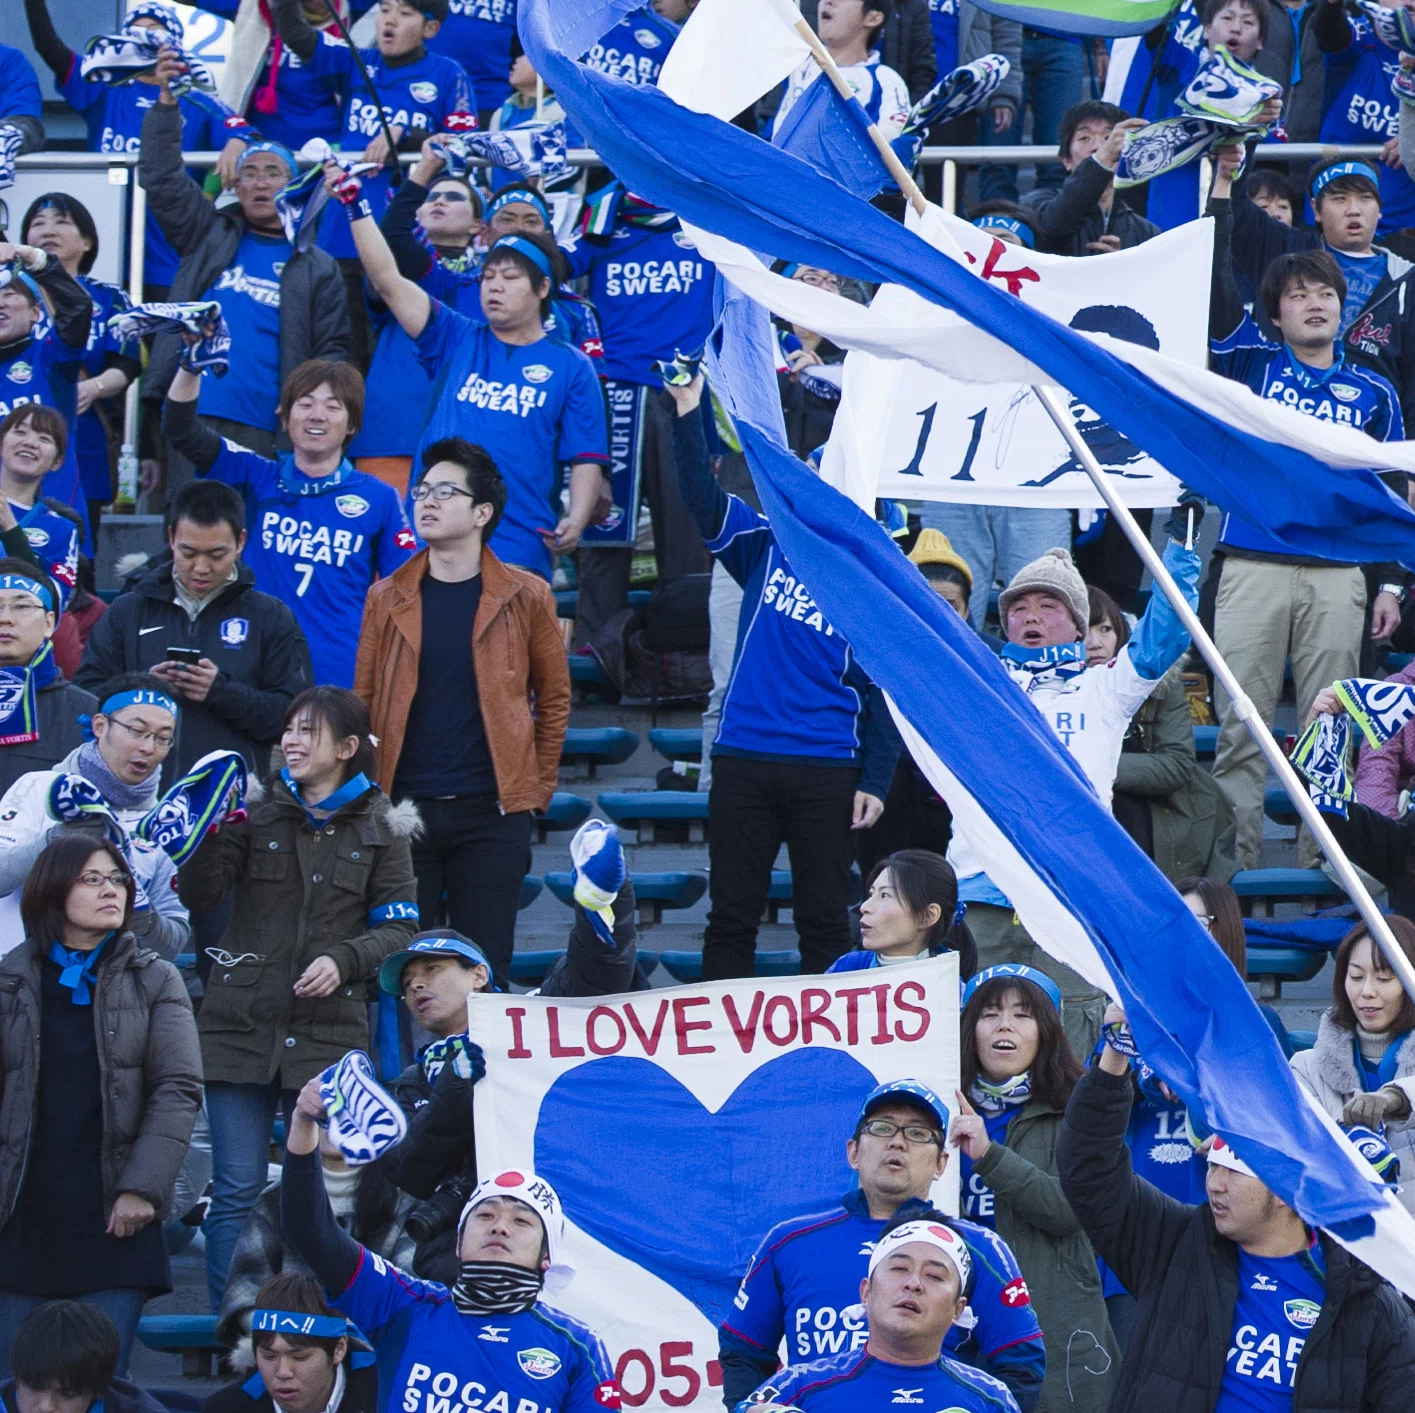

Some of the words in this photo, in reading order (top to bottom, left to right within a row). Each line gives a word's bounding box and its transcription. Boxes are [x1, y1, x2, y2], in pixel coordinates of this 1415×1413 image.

[1316, 164, 1379, 186] J1へ!!
[606, 260, 703, 286] POCARI
[606, 276, 692, 297] SWEAT
[899, 402, 988, 482] 11
[260, 531, 351, 568] SWEAT
[262, 511, 365, 555] POCARI
[296, 564, 314, 597] 7
[505, 1006, 534, 1060] I
[548, 996, 716, 1058] LOVE
[721, 980, 932, 1056] VORTIS
[258, 1312, 317, 1336] J1へ!!
